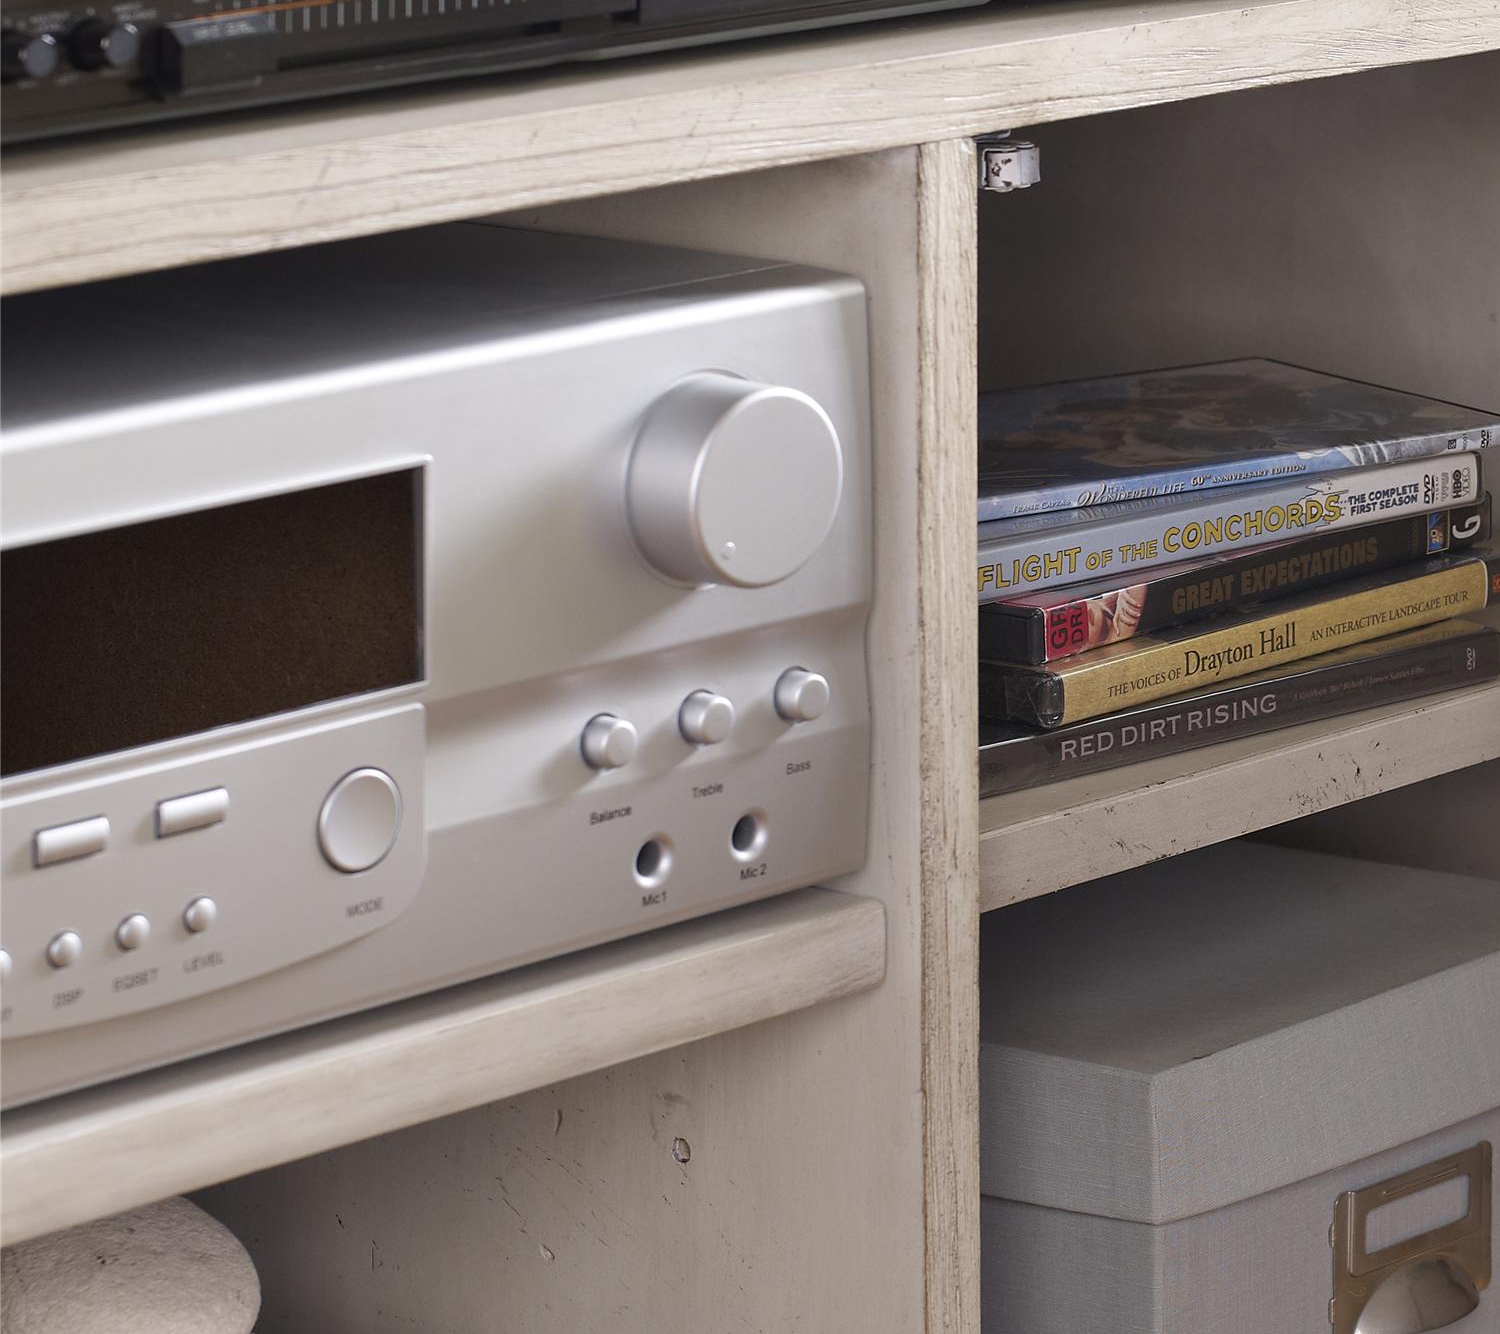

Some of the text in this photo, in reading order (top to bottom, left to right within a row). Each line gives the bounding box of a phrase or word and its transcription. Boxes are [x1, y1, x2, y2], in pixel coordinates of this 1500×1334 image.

[1076, 480, 1160, 507] WONDERFUL
[1163, 481, 1186, 495] LIFE
[1212, 469, 1269, 484] ANNIVERSARY
[1271, 463, 1306, 476] EDITION
[1424, 474, 1432, 504] DVD
[1452, 469, 1462, 499] HBO
[1462, 466, 1471, 498] VIDEO
[1349, 482, 1420, 506] THE COMPLETE
[1350, 493, 1418, 516] FIRST SEASON
[1012, 504, 1039, 514] FRANK
[977, 494, 1343, 592] FLIGHT OF THE CONCHORDS
[1172, 537, 1378, 615] GREAT EXPECTATIONS
[1107, 590, 1469, 699] THE VOICES OF Drayton Hall AN INTERACTIVE LANDSCAPE TOUR
[1466, 647, 1474, 670] DVD
[1060, 693, 1278, 761] RED DIRT RISING
[786, 759, 812, 776] Bass
[692, 781, 724, 799] Treble
[589, 804, 632, 826] Balance
[740, 863, 767, 881] Mic 2
[345, 897, 384, 919] MODE
[642, 891, 667, 907] Mic 1
[183, 951, 224, 973] LEVEL
